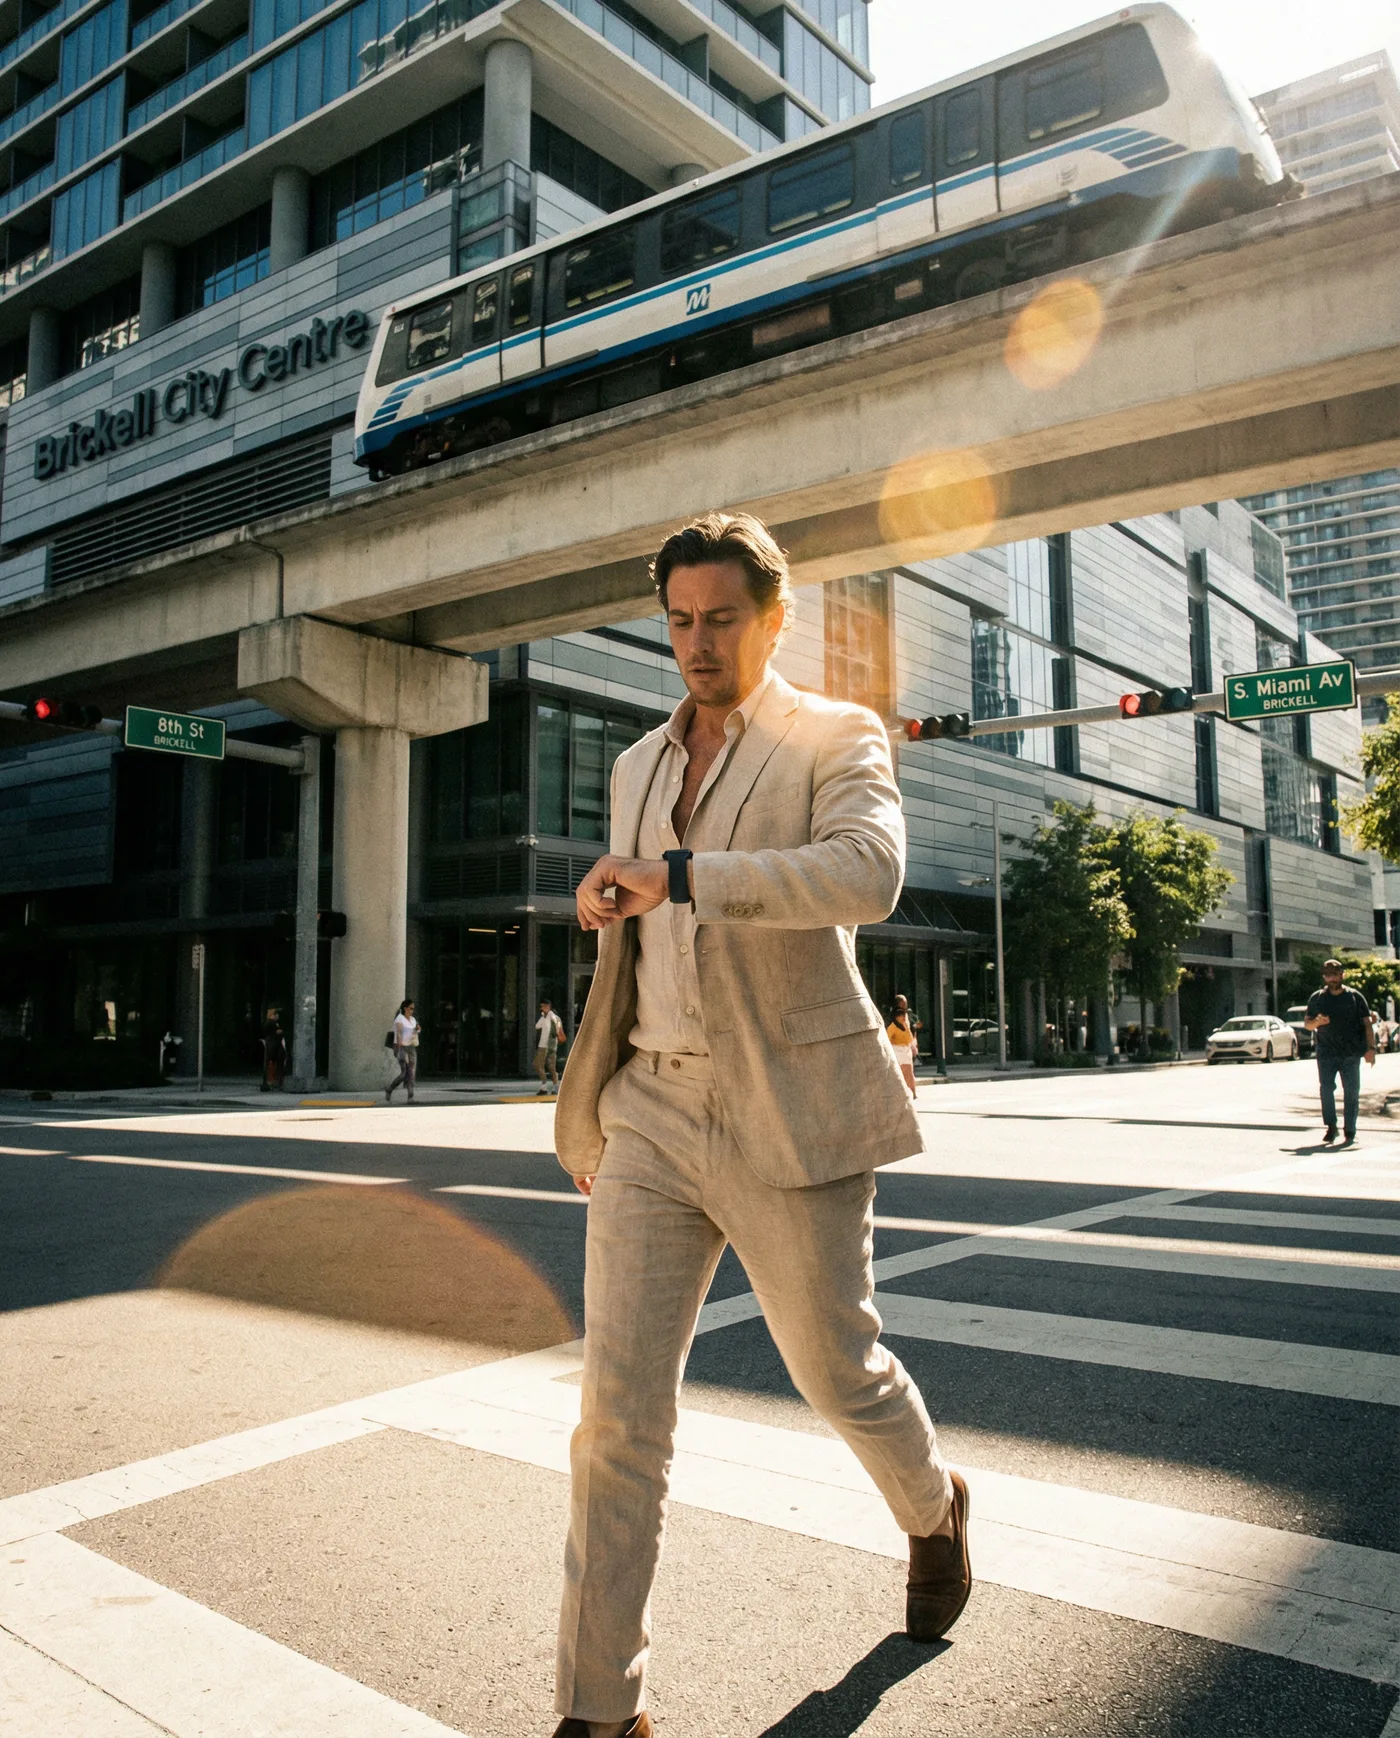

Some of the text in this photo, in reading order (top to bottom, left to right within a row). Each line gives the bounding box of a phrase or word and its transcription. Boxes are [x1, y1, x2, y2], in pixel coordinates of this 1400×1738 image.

[34, 309, 369, 480] Brickell City Centre
[1234, 671, 1343, 699] S. Miami Av
[1263, 695, 1317, 710] BRICKELL
[158, 717, 204, 738] 8th St
